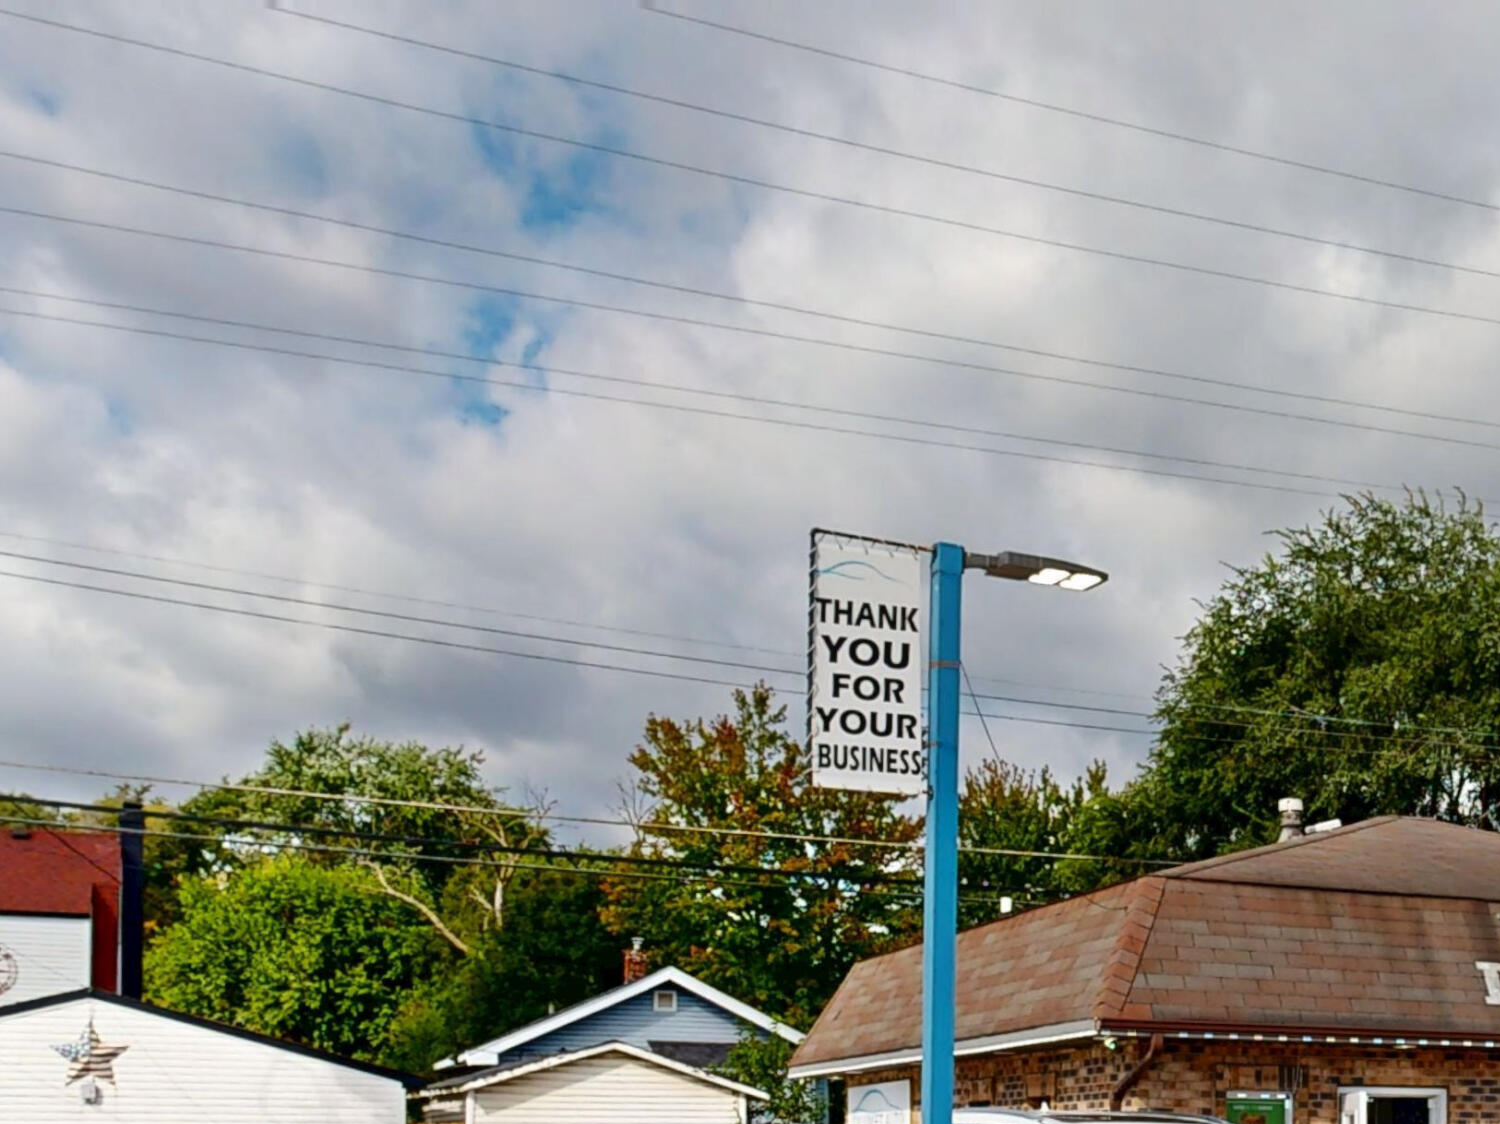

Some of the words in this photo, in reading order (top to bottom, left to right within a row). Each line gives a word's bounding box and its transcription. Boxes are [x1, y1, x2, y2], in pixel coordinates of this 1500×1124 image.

[815, 597, 919, 632] THANK
[821, 635, 910, 669] YOU
[832, 673, 905, 703] FOR
[816, 707, 917, 739] YOUR
[818, 744, 921, 775] BUSINESS
